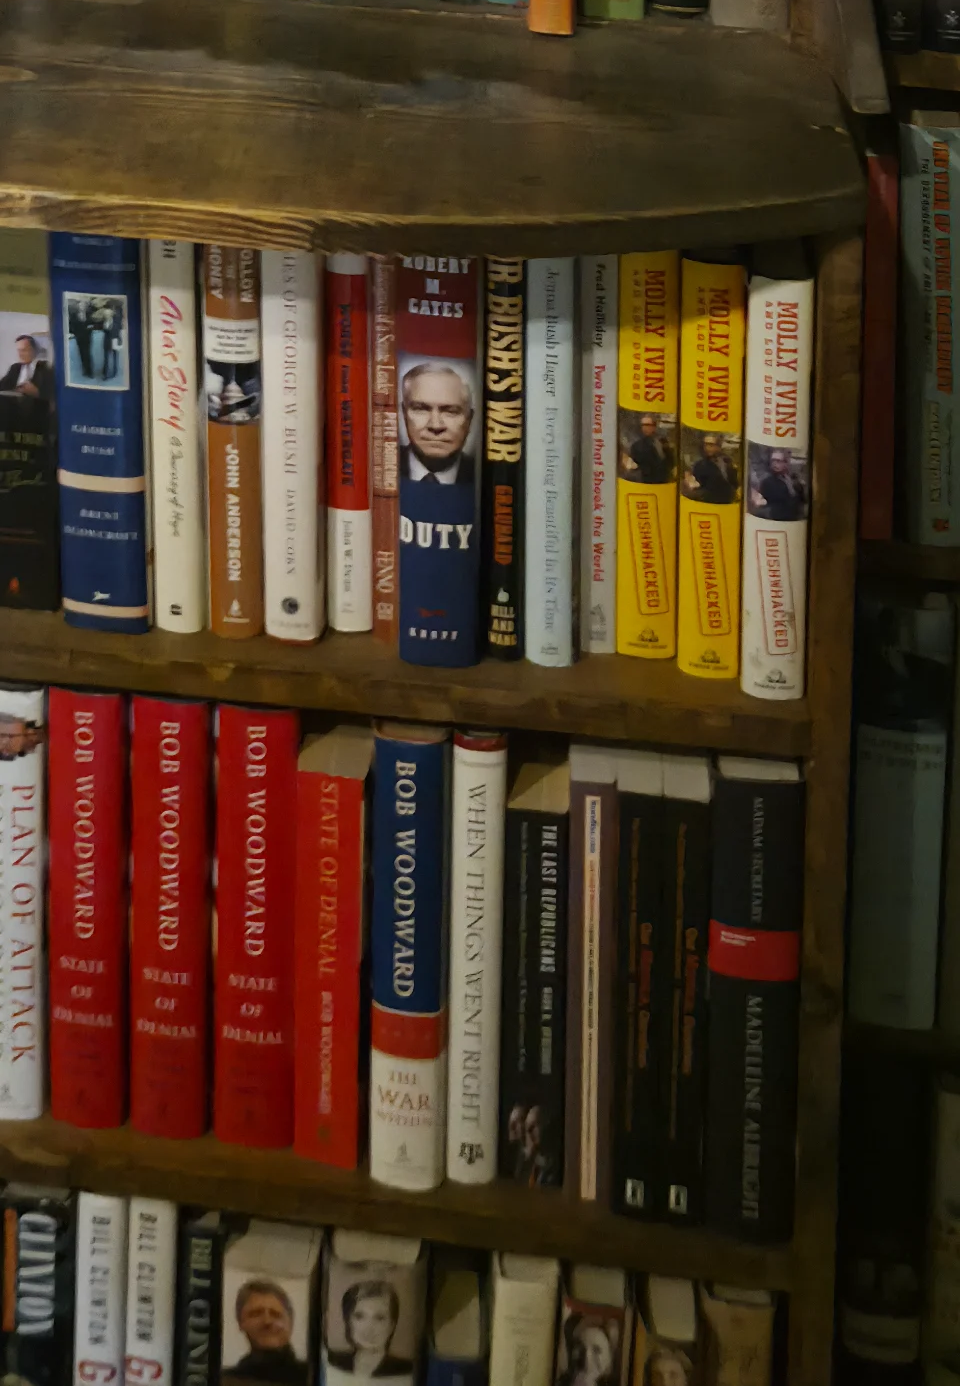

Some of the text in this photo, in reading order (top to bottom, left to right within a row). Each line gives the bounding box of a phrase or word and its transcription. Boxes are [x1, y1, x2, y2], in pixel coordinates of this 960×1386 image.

[486, 296, 523, 462] BUSH'S WAR
[642, 269, 665, 402] MOLLY IVINS
[706, 289, 730, 422] MOLLY IVINS
[775, 302, 799, 439] MOLLY IVINS
[225, 443, 242, 583] JOHN ANDERSON
[399, 520, 474, 549] DUTY
[592, 365, 606, 582] Two Hours that Shook the World
[636, 500, 662, 610] BUSHWHACKED
[701, 520, 723, 631] BUSHWHACKED
[766, 537, 789, 649] BUSHWHACKED
[74, 711, 95, 939] BOB WOODWARD
[158, 721, 180, 951] BOB WOODWARD
[245, 726, 267, 957] BOB WOODWARD
[393, 760, 416, 997] BOB WOODWARD
[11, 785, 35, 1063] PLAN OF ATTACK
[461, 784, 486, 1126] WHEN THINGS WENT RIGHT
[89, 1216, 110, 1343] BILL CLINTON
